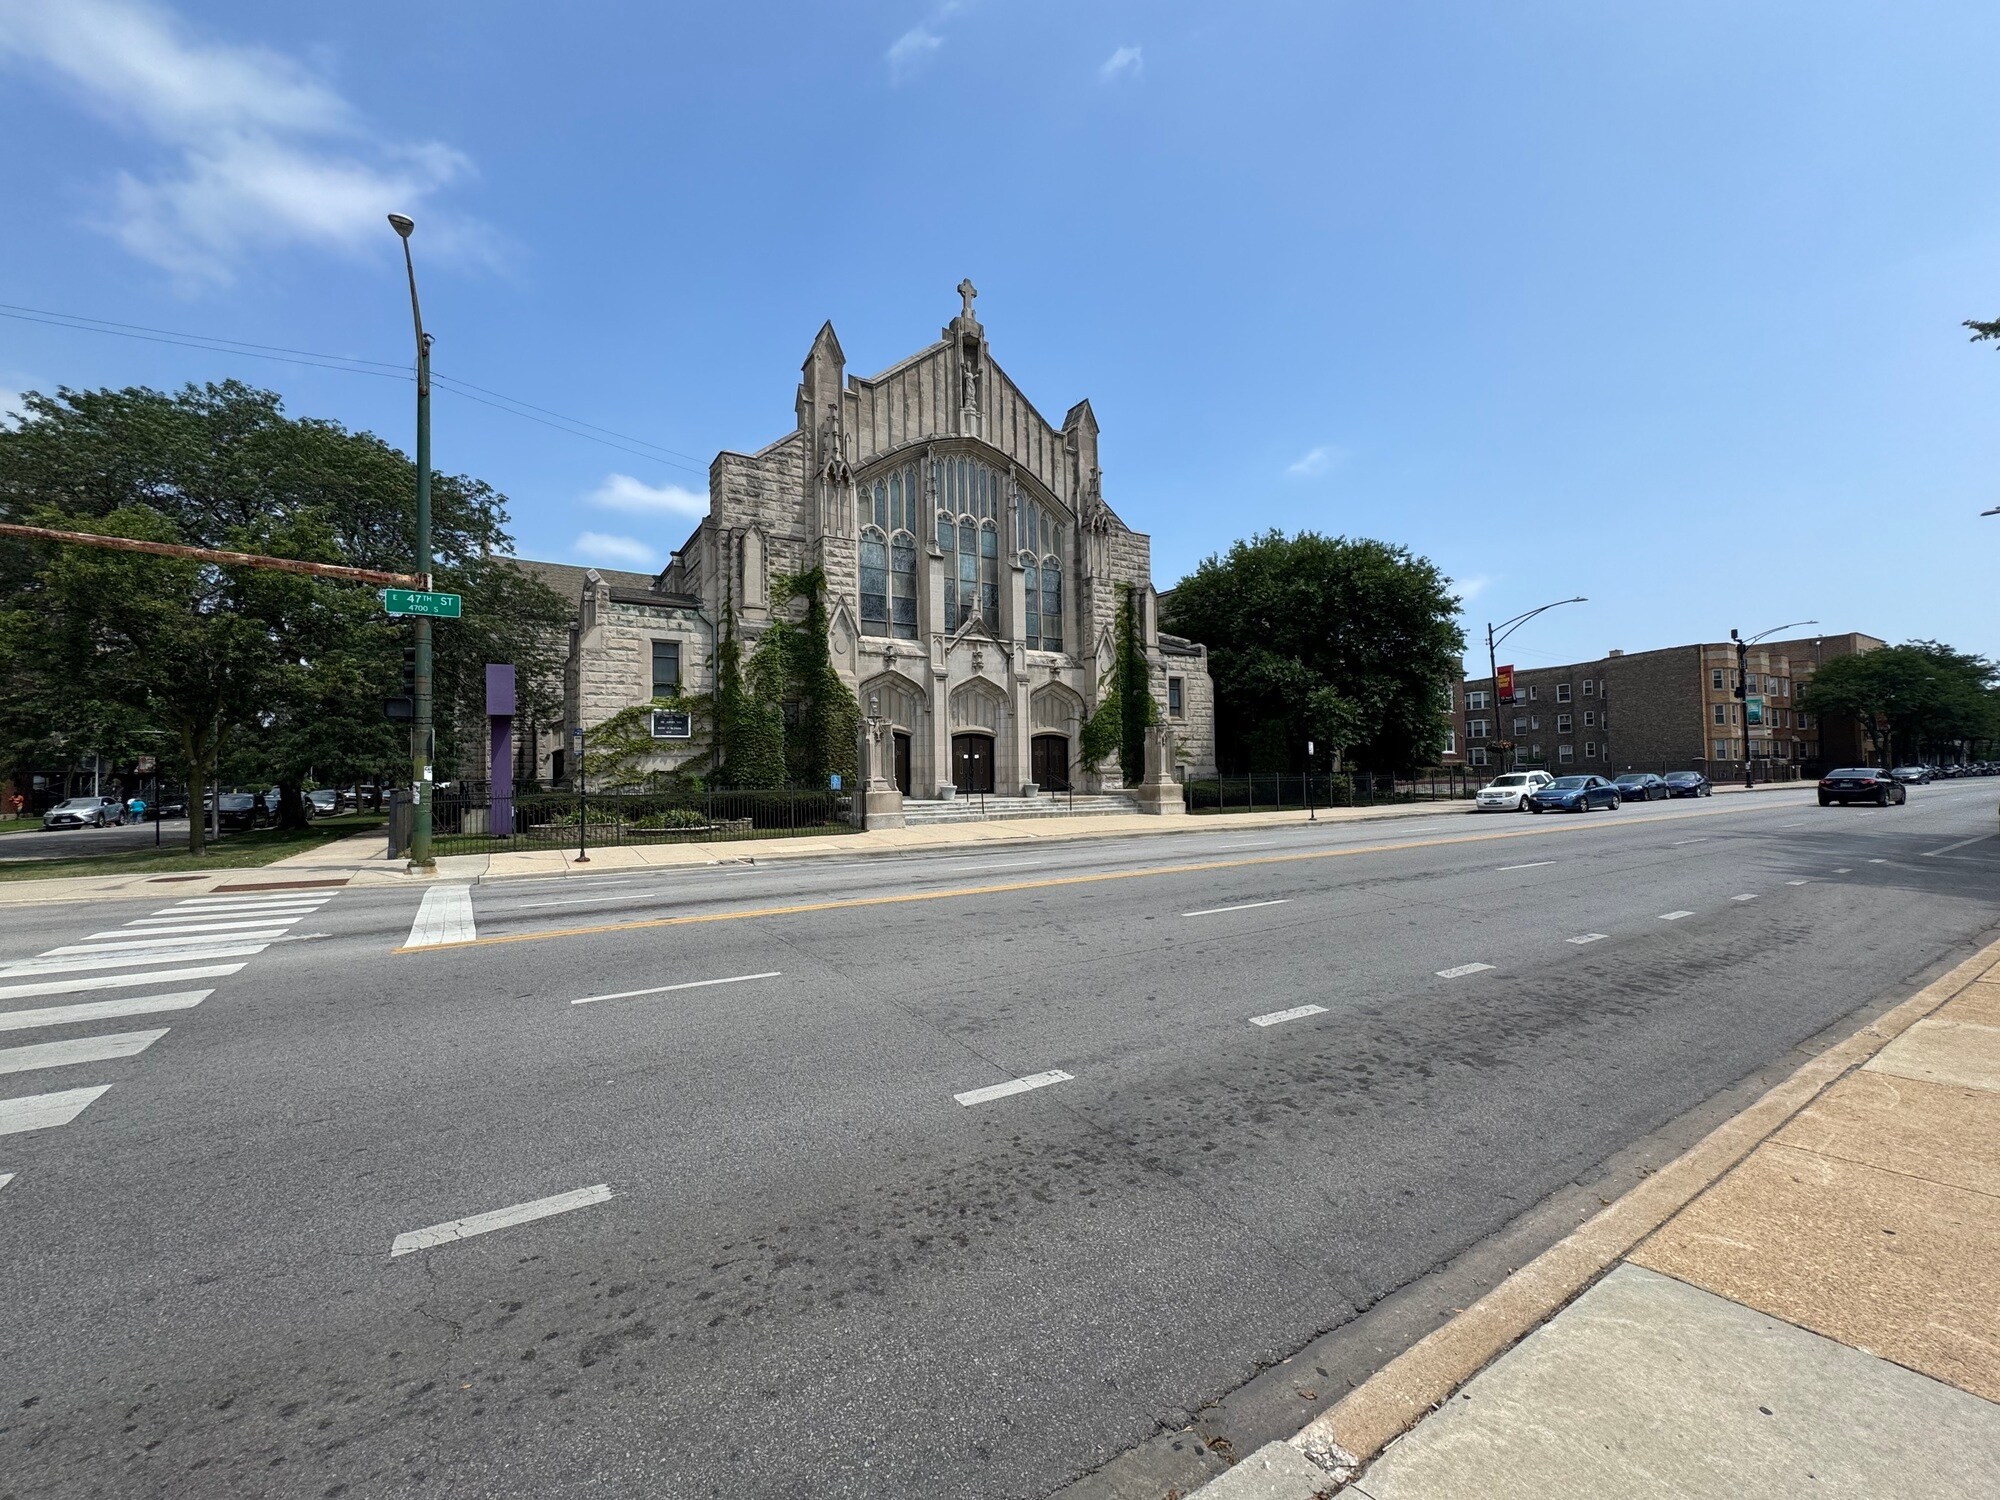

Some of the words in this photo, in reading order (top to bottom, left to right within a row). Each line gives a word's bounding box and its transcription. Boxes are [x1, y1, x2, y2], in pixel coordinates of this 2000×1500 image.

[406, 594, 432, 604] 47TH
[440, 597, 453, 606] ST
[408, 604, 429, 612] 4700
